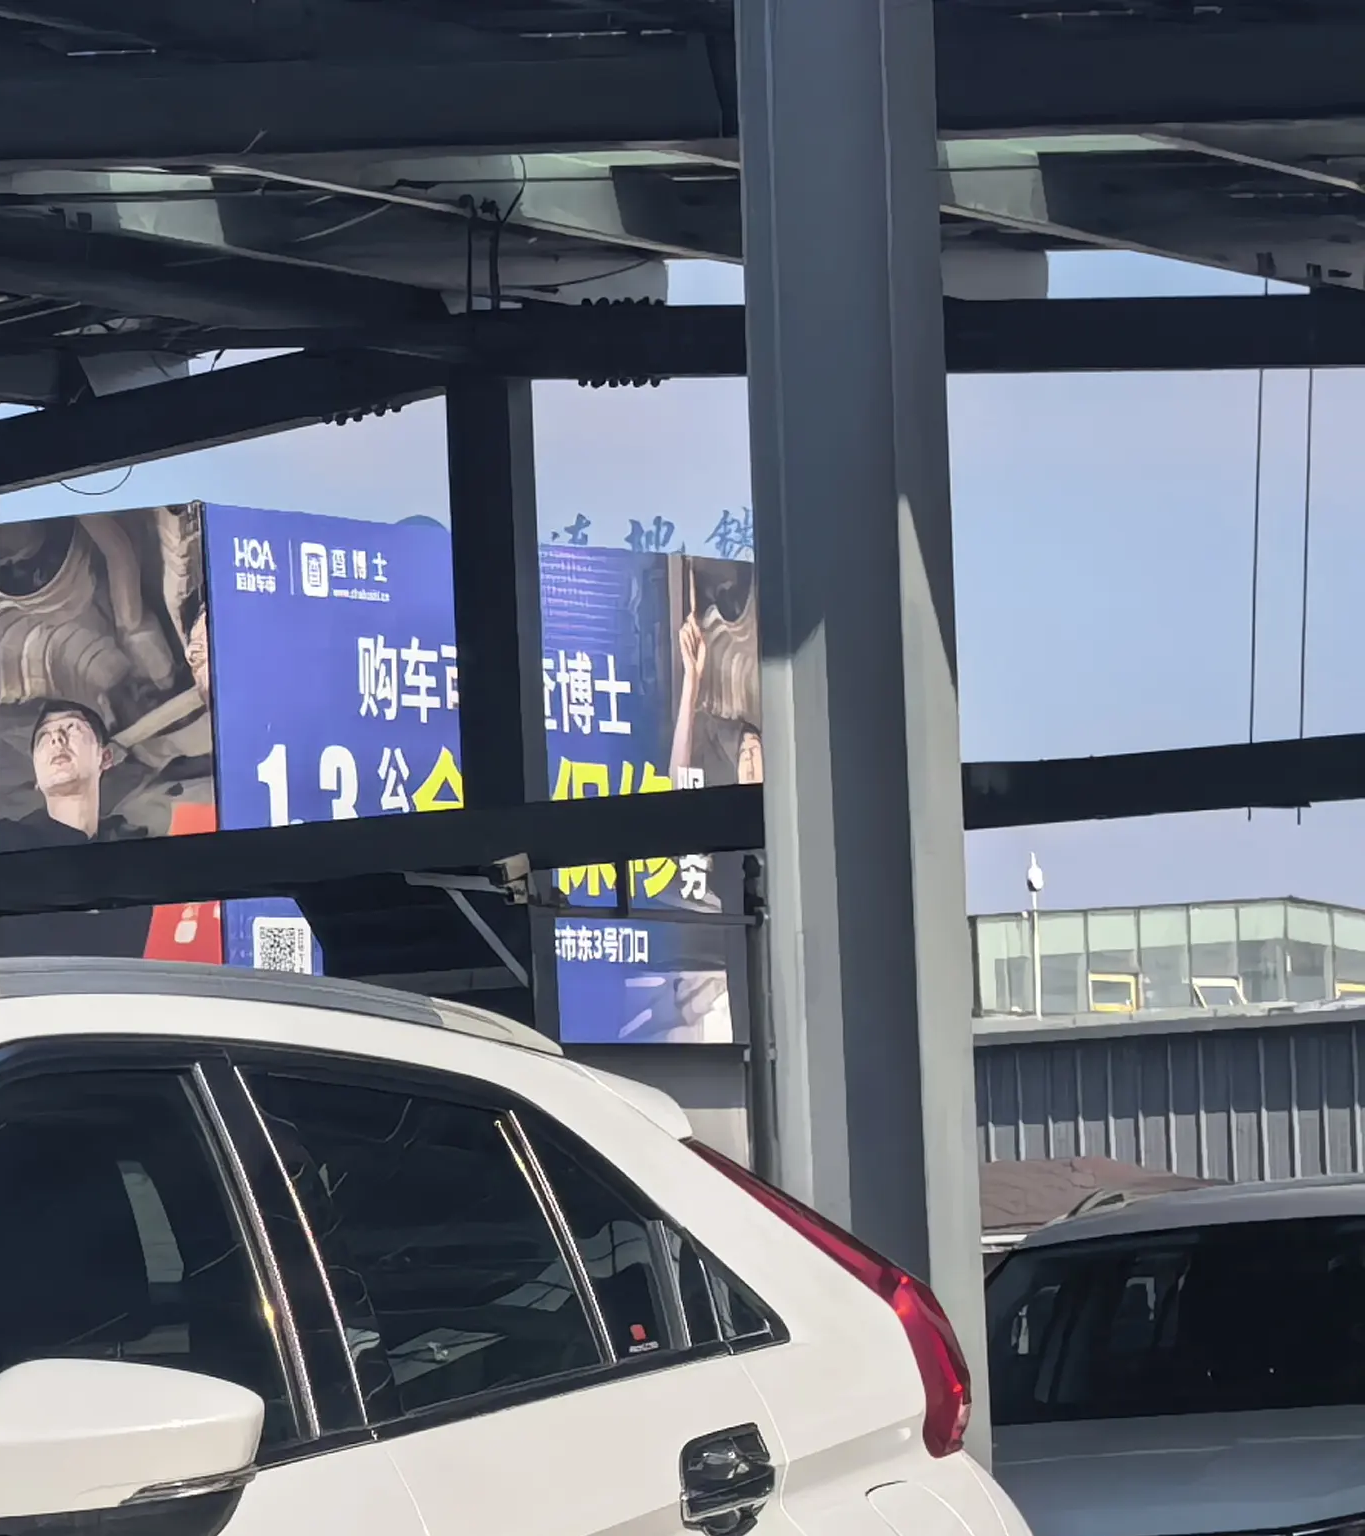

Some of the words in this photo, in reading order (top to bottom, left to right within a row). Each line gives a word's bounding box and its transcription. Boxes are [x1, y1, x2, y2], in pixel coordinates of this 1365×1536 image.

[233, 537, 277, 571] HOA
[331, 549, 388, 583] 查博士
